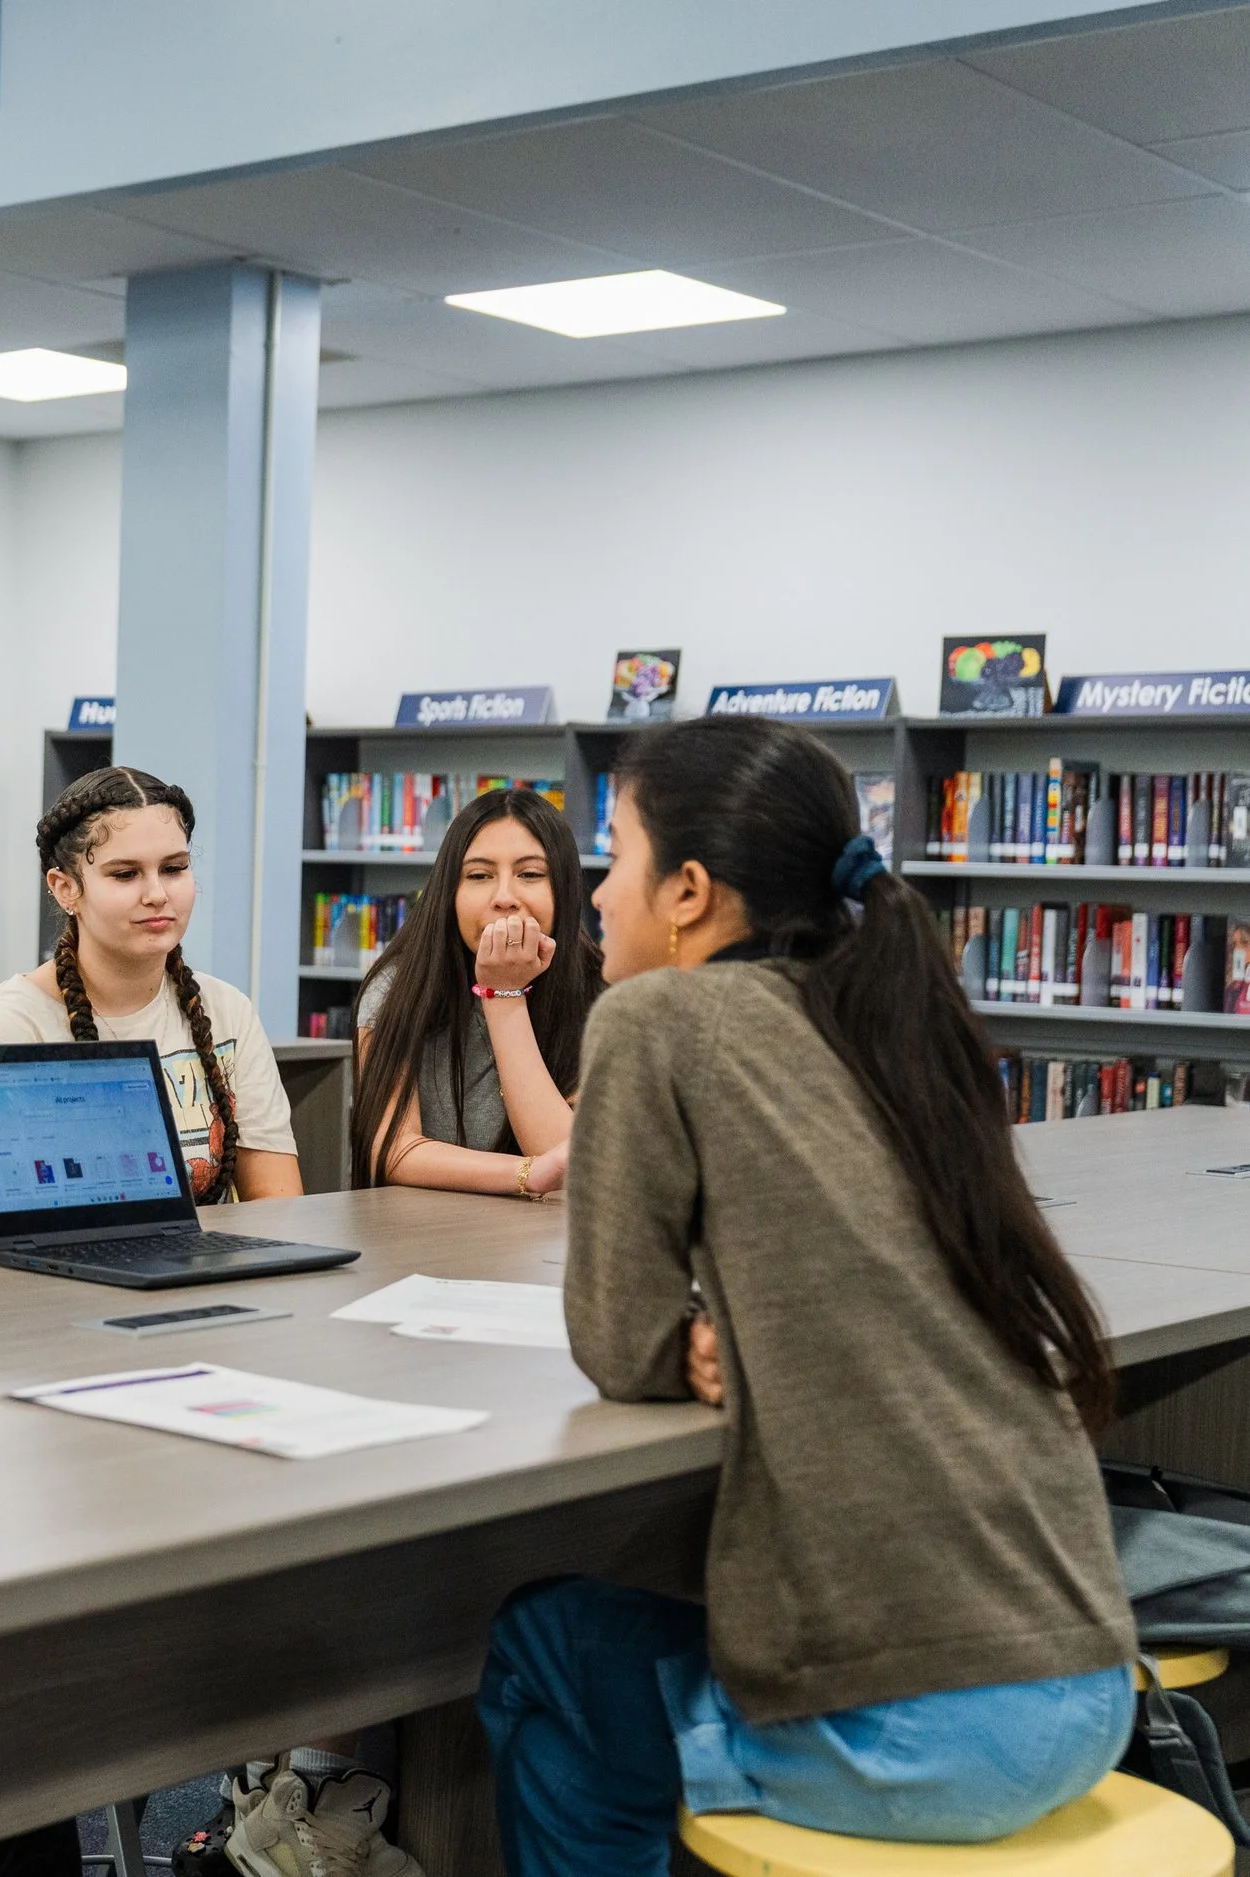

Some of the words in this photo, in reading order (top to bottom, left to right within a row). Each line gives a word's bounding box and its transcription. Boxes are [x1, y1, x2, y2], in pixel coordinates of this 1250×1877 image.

[417, 694, 468, 727] Sports
[467, 692, 525, 720] Fiction
[712, 688, 812, 714] Adventure
[812, 684, 881, 713] Fiction
[1077, 679, 1183, 713] Mystery
